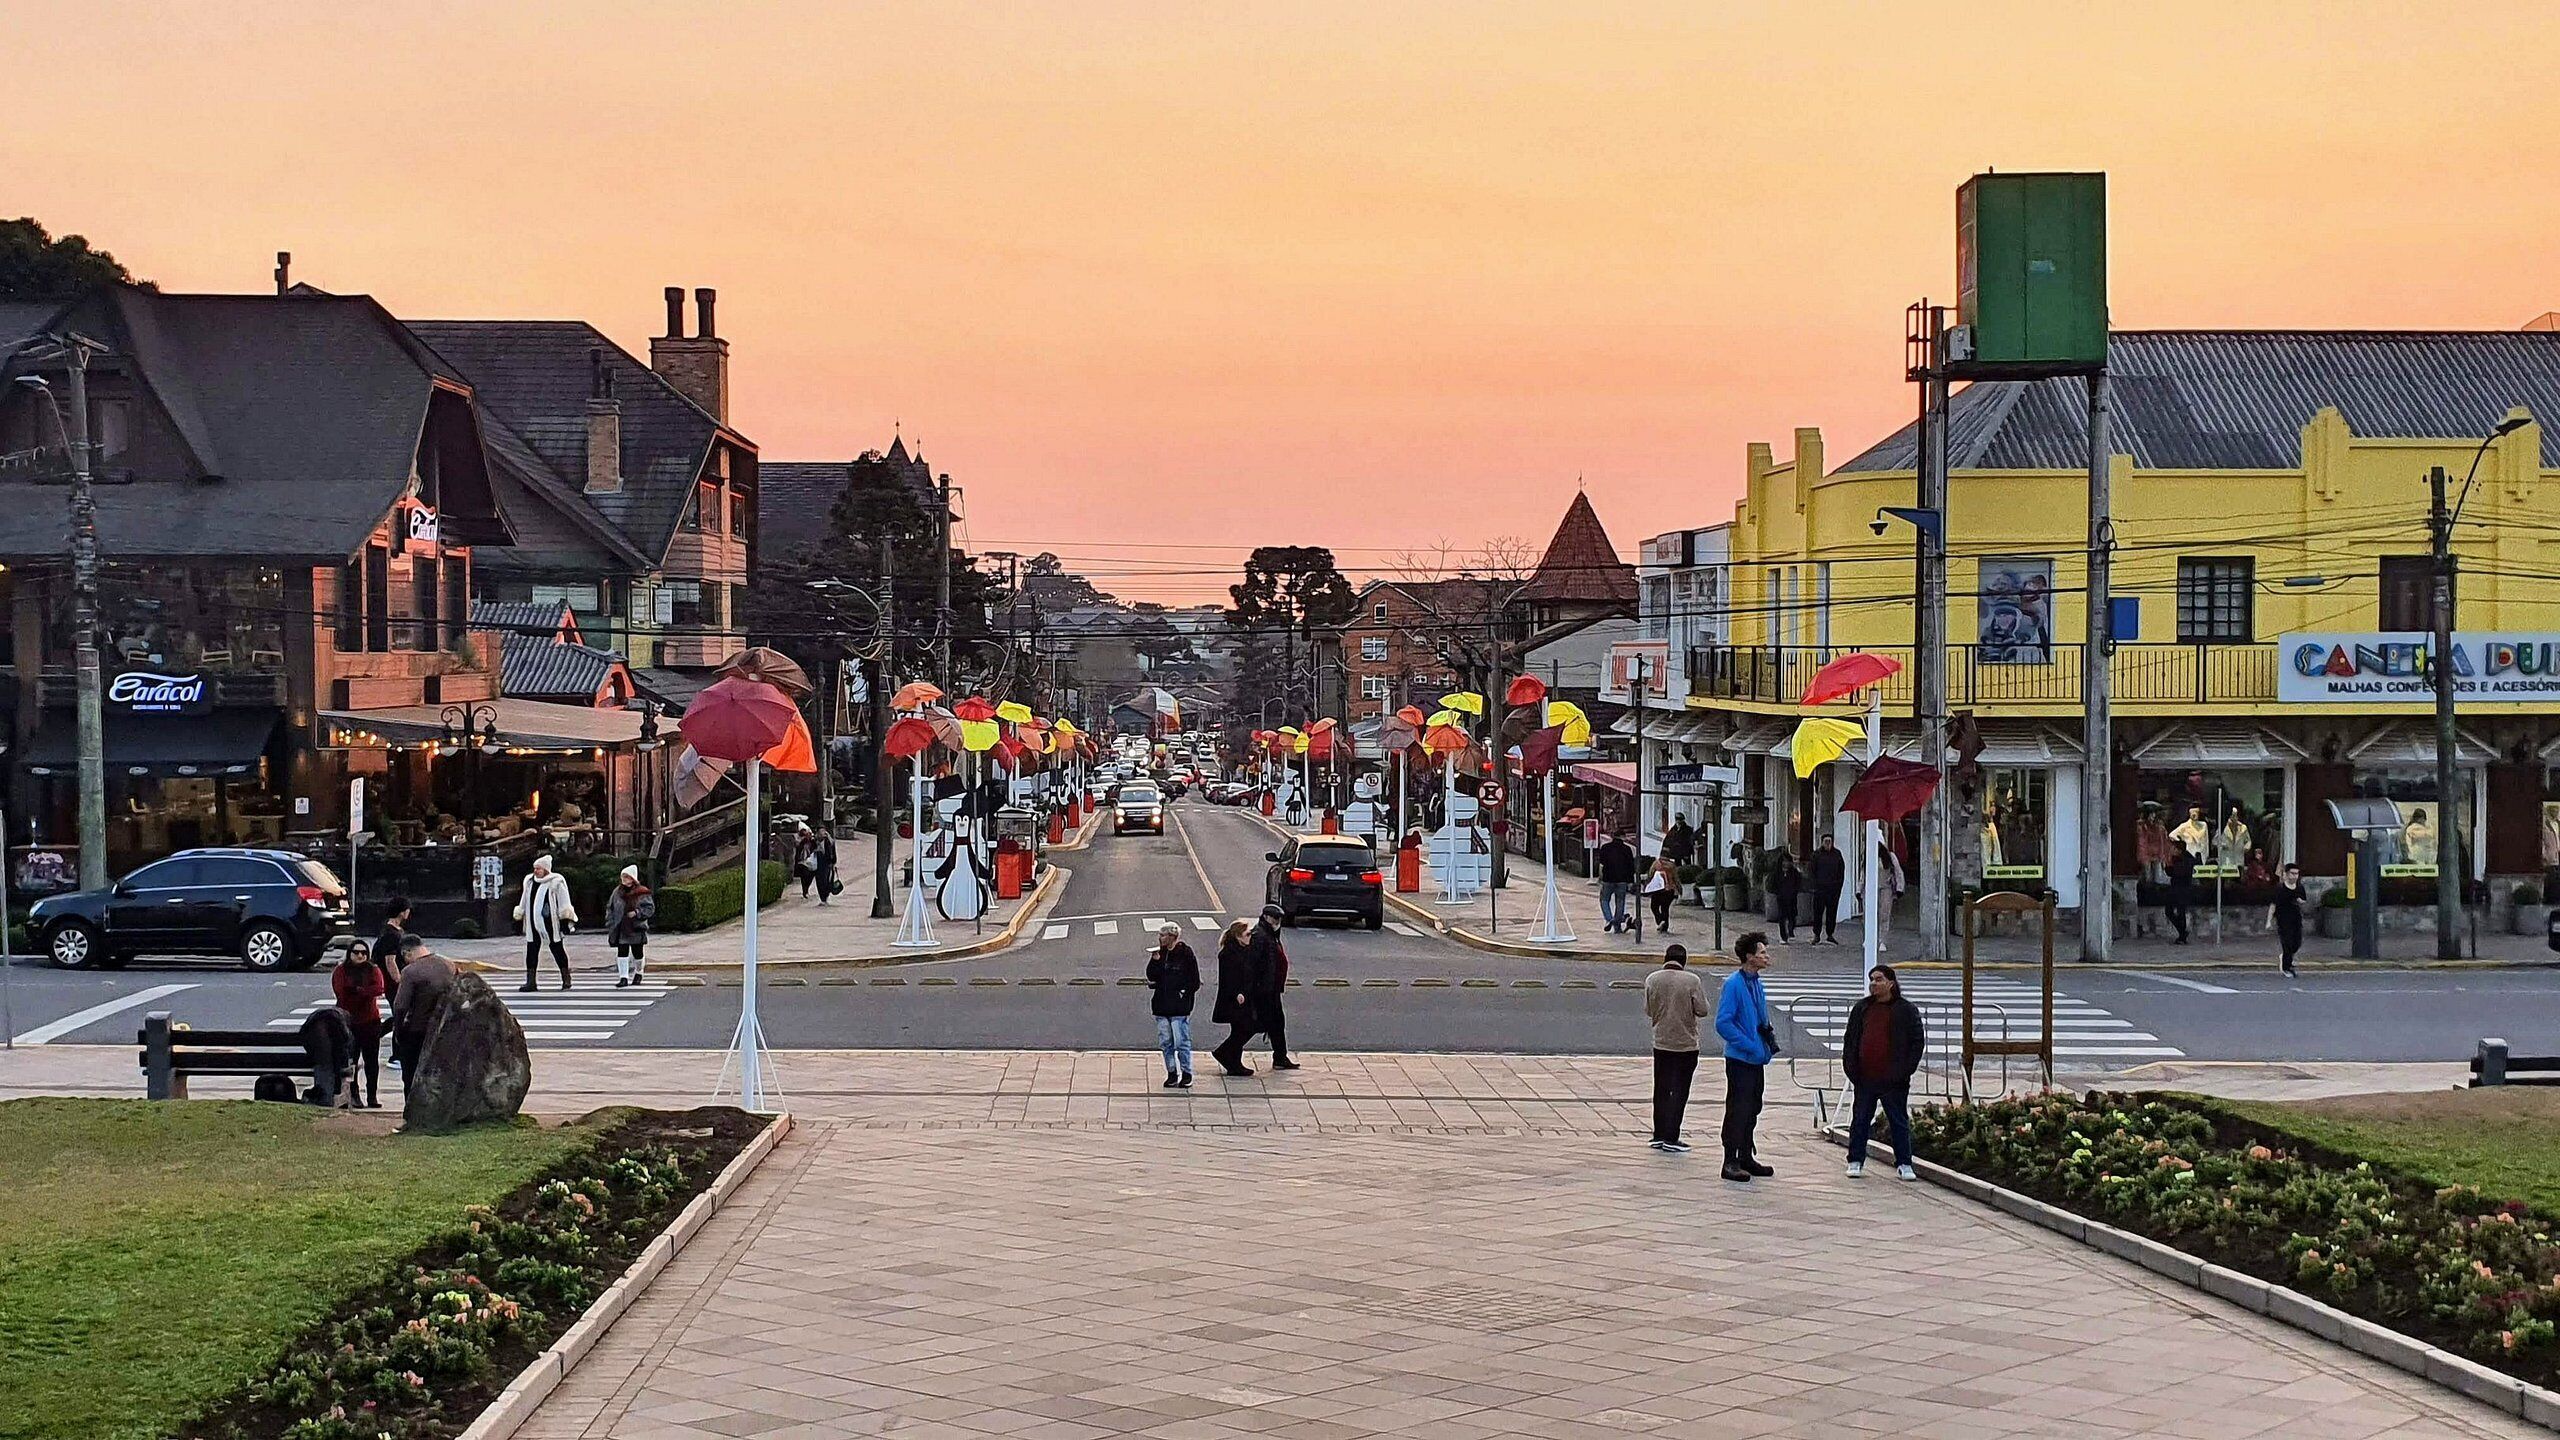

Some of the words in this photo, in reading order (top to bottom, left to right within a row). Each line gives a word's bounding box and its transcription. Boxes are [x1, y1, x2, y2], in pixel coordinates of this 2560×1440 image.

[109, 672, 202, 702] Caracol
[2327, 682, 2382, 693] MALHAS
[2481, 681, 2489, 692] E
